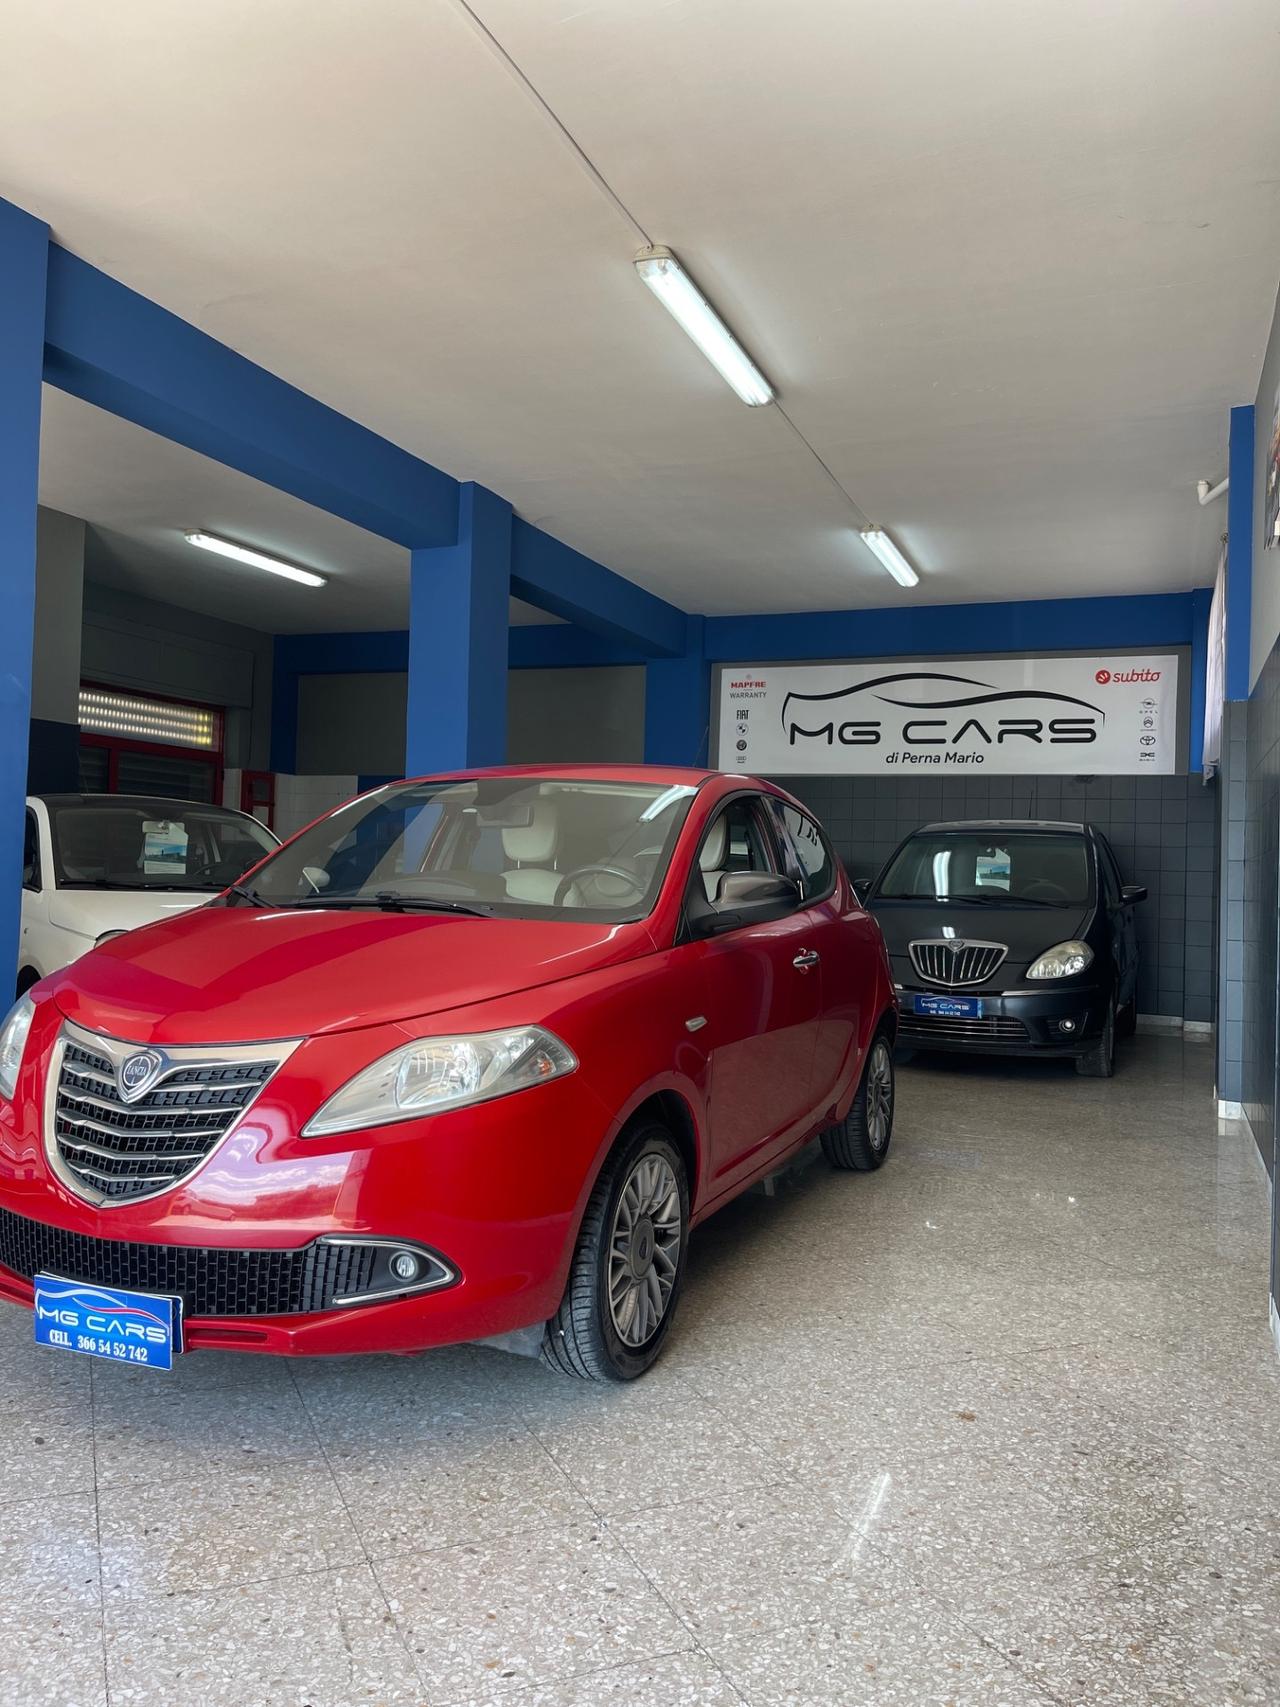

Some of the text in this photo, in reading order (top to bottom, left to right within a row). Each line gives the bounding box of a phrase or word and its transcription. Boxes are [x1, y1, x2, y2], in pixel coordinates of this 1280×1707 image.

[1113, 668, 1161, 683] subito
[736, 709, 750, 720] FIAT
[790, 718, 1097, 745] MG CARS
[885, 751, 984, 764] di Perna Mario
[39, 1306, 166, 1344] MG CARS
[50, 1329, 148, 1362] CELL. 366 54 52 742
